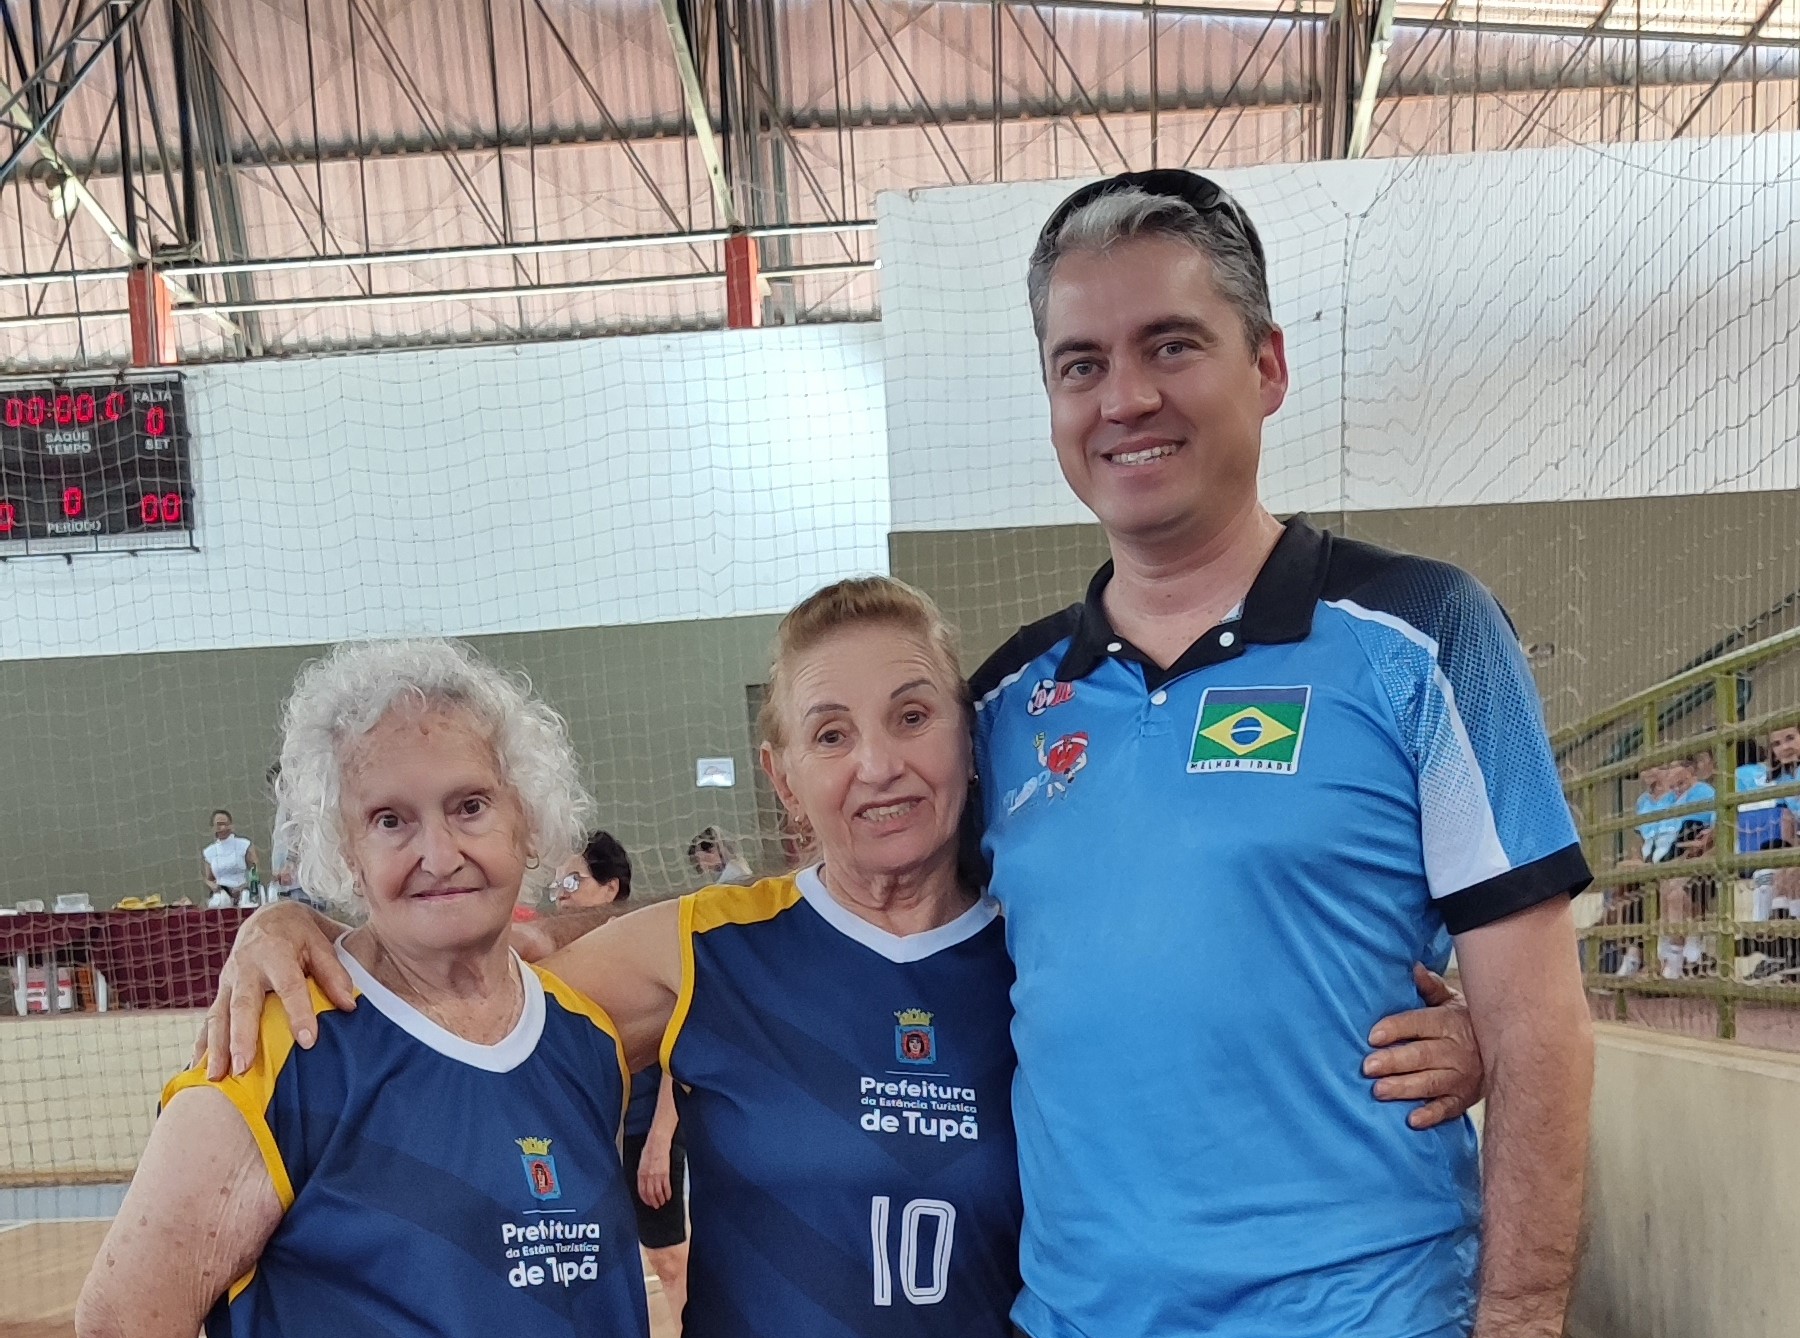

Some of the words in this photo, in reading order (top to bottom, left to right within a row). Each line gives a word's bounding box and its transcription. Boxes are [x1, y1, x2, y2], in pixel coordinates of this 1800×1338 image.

[147, 406, 165, 435] 0
[45, 431, 89, 443] SAQUE
[46, 443, 92, 455] TEMPO
[145, 438, 170, 450] SET
[64, 487, 82, 515] 0
[142, 493, 181, 523] 00
[1190, 760, 1241, 770] MELHOR
[1250, 760, 1292, 772] IDADE
[860, 1076, 976, 1102] Prefeitura
[860, 1096, 877, 1106] da
[879, 1097, 928, 1110] Estância
[860, 1108, 900, 1133] de
[902, 1110, 979, 1143] Tupã
[505, 1248, 520, 1259] da
[870, 1196, 957, 1306] 10
[508, 1260, 545, 1288] de
